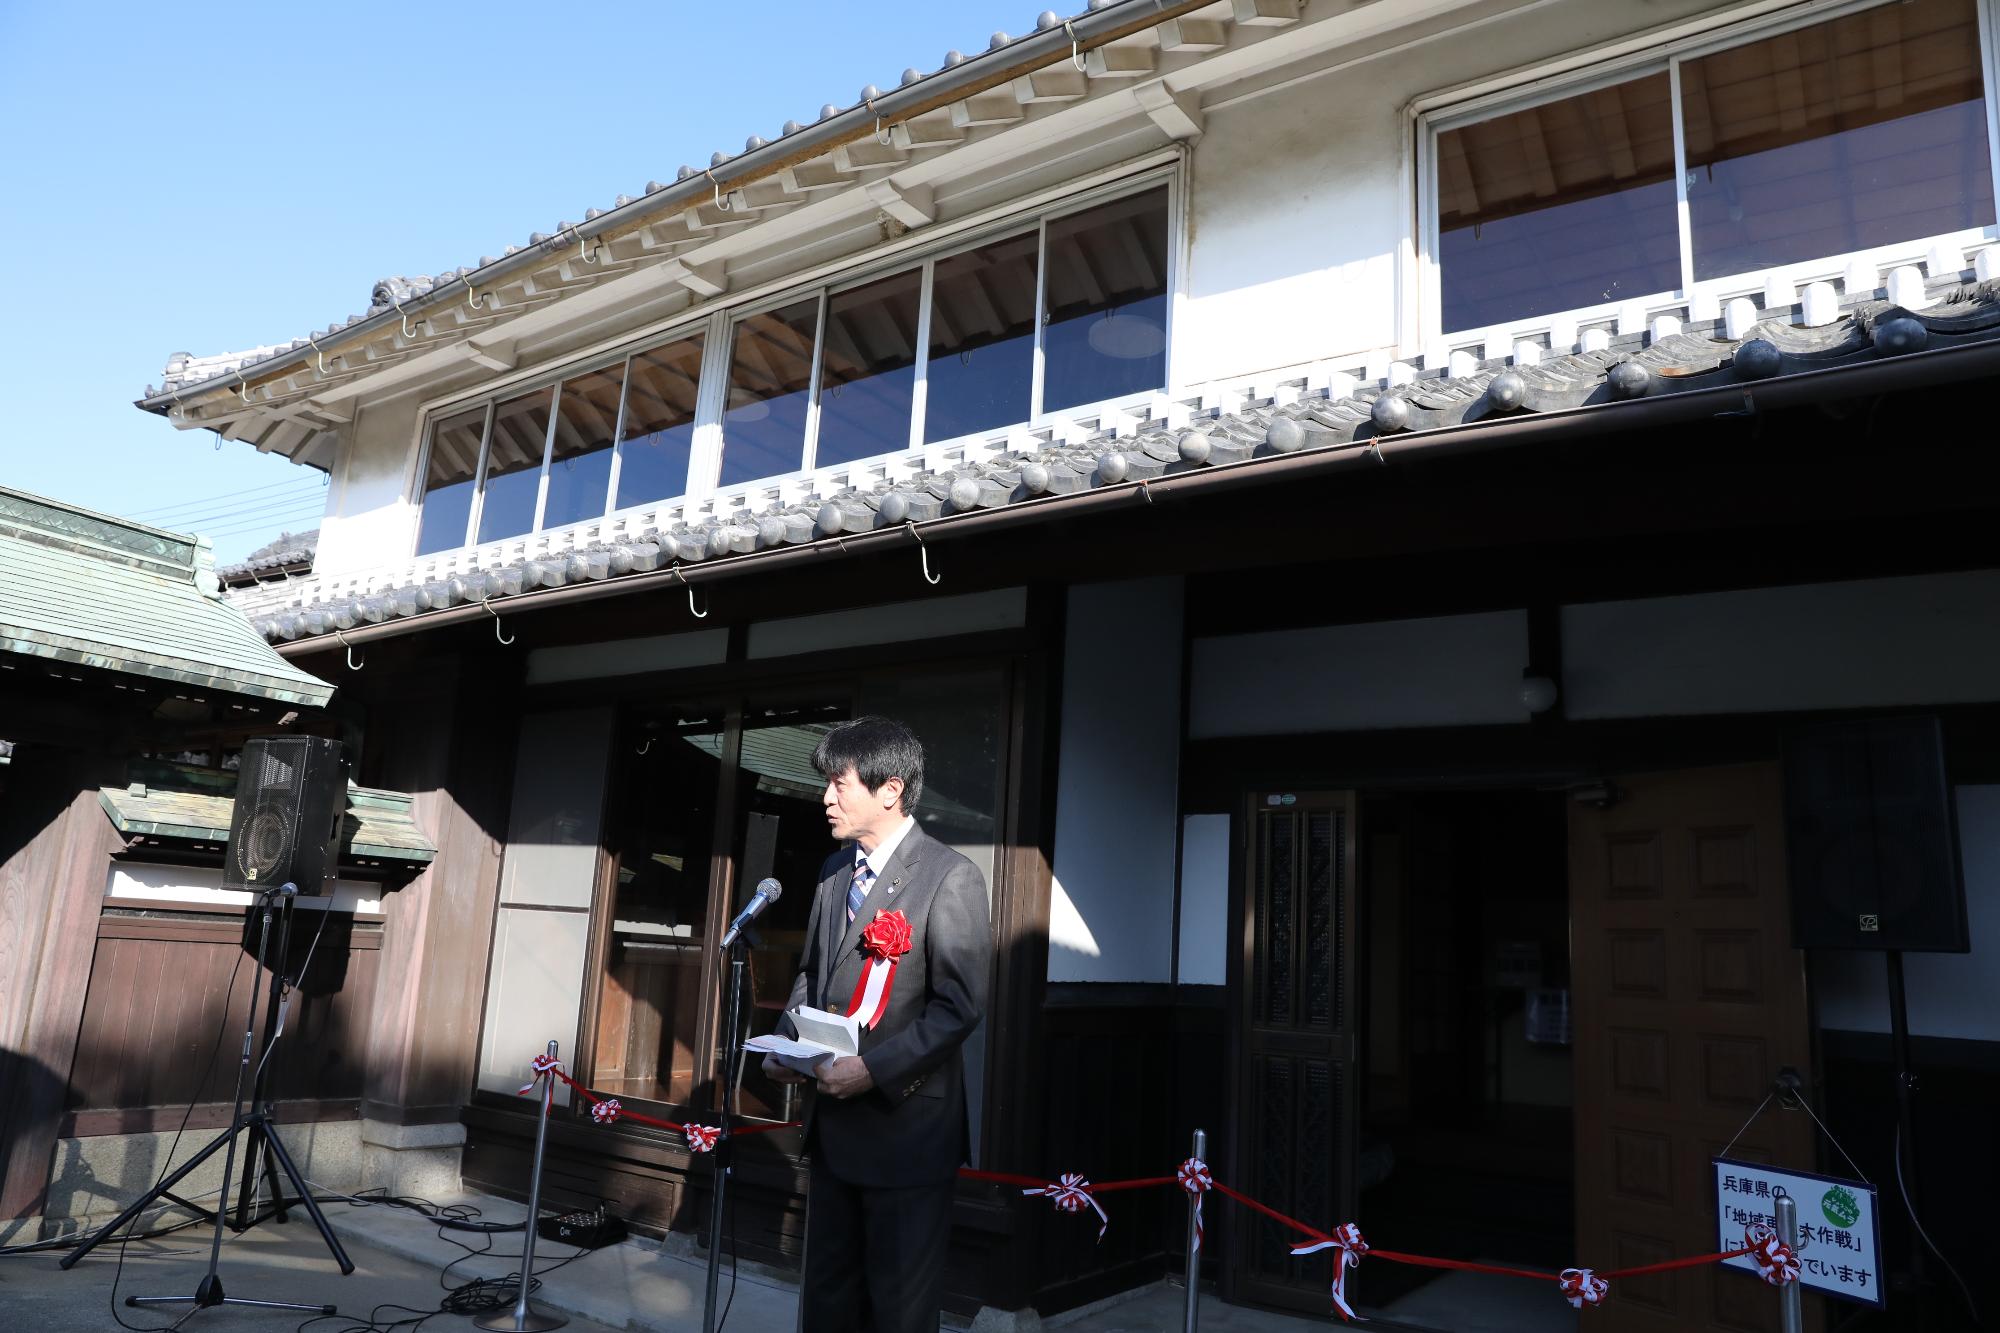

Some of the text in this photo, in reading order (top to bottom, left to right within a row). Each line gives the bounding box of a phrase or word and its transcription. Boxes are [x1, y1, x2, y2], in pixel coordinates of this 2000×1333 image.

[1723, 1175, 1786, 1199] 兵庫県の
[1725, 1205, 1861, 1253] 「地域再大作戦」
